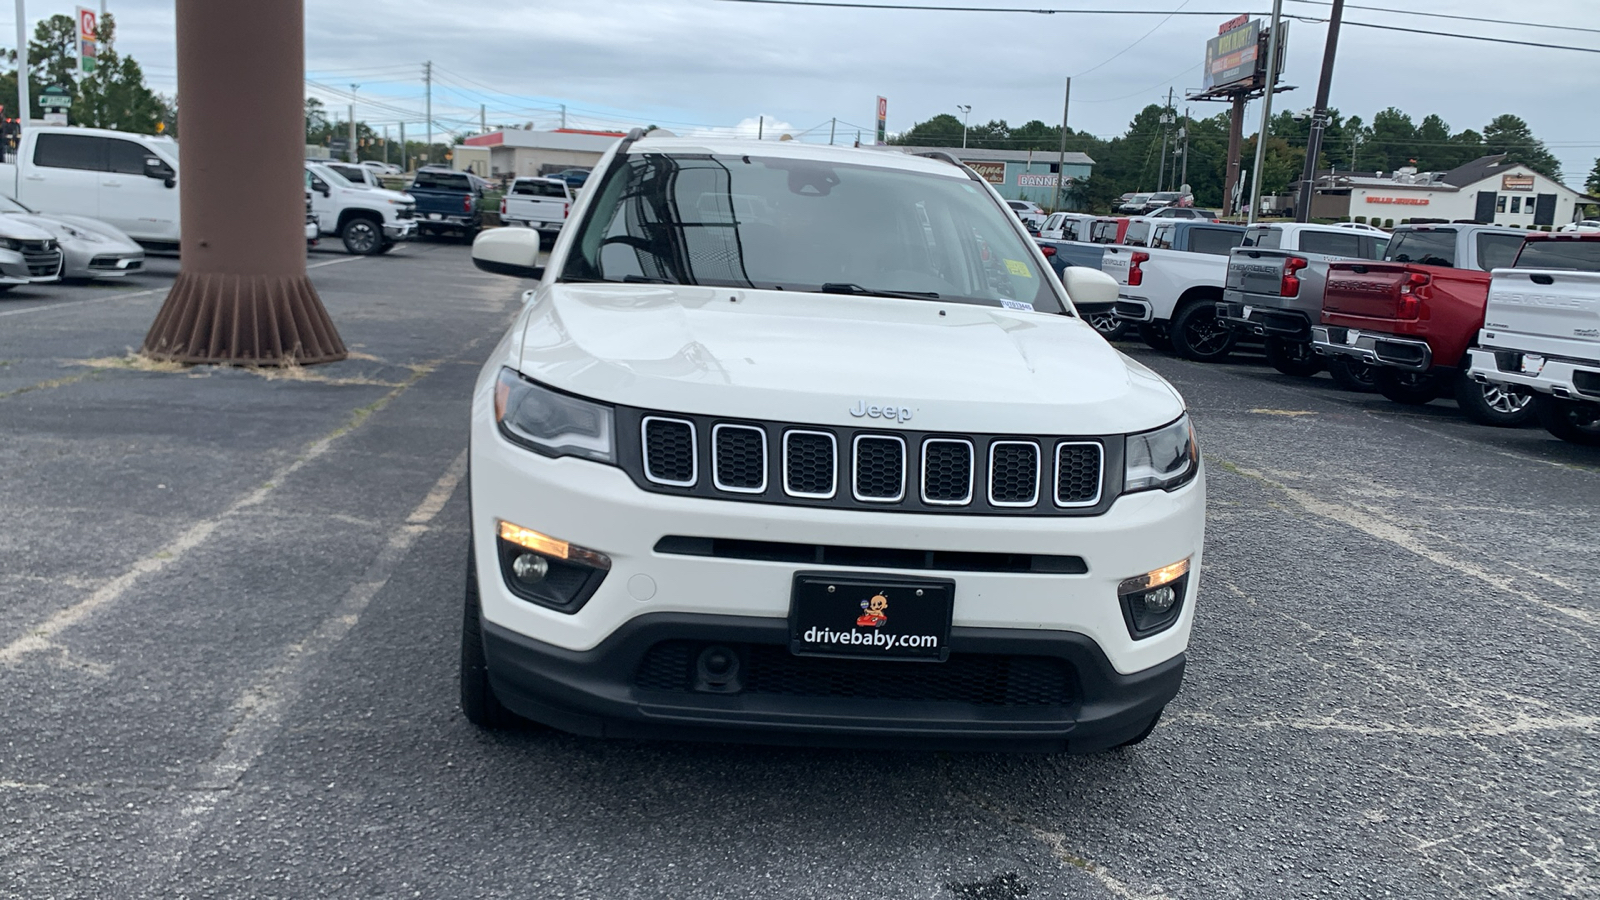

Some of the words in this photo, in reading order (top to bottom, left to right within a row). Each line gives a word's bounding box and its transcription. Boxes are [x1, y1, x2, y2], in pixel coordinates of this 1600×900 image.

[1230, 263, 1278, 274] CHEVROLET
[849, 399, 913, 424] Jeep
[803, 626, 938, 650] drivebaby.com
